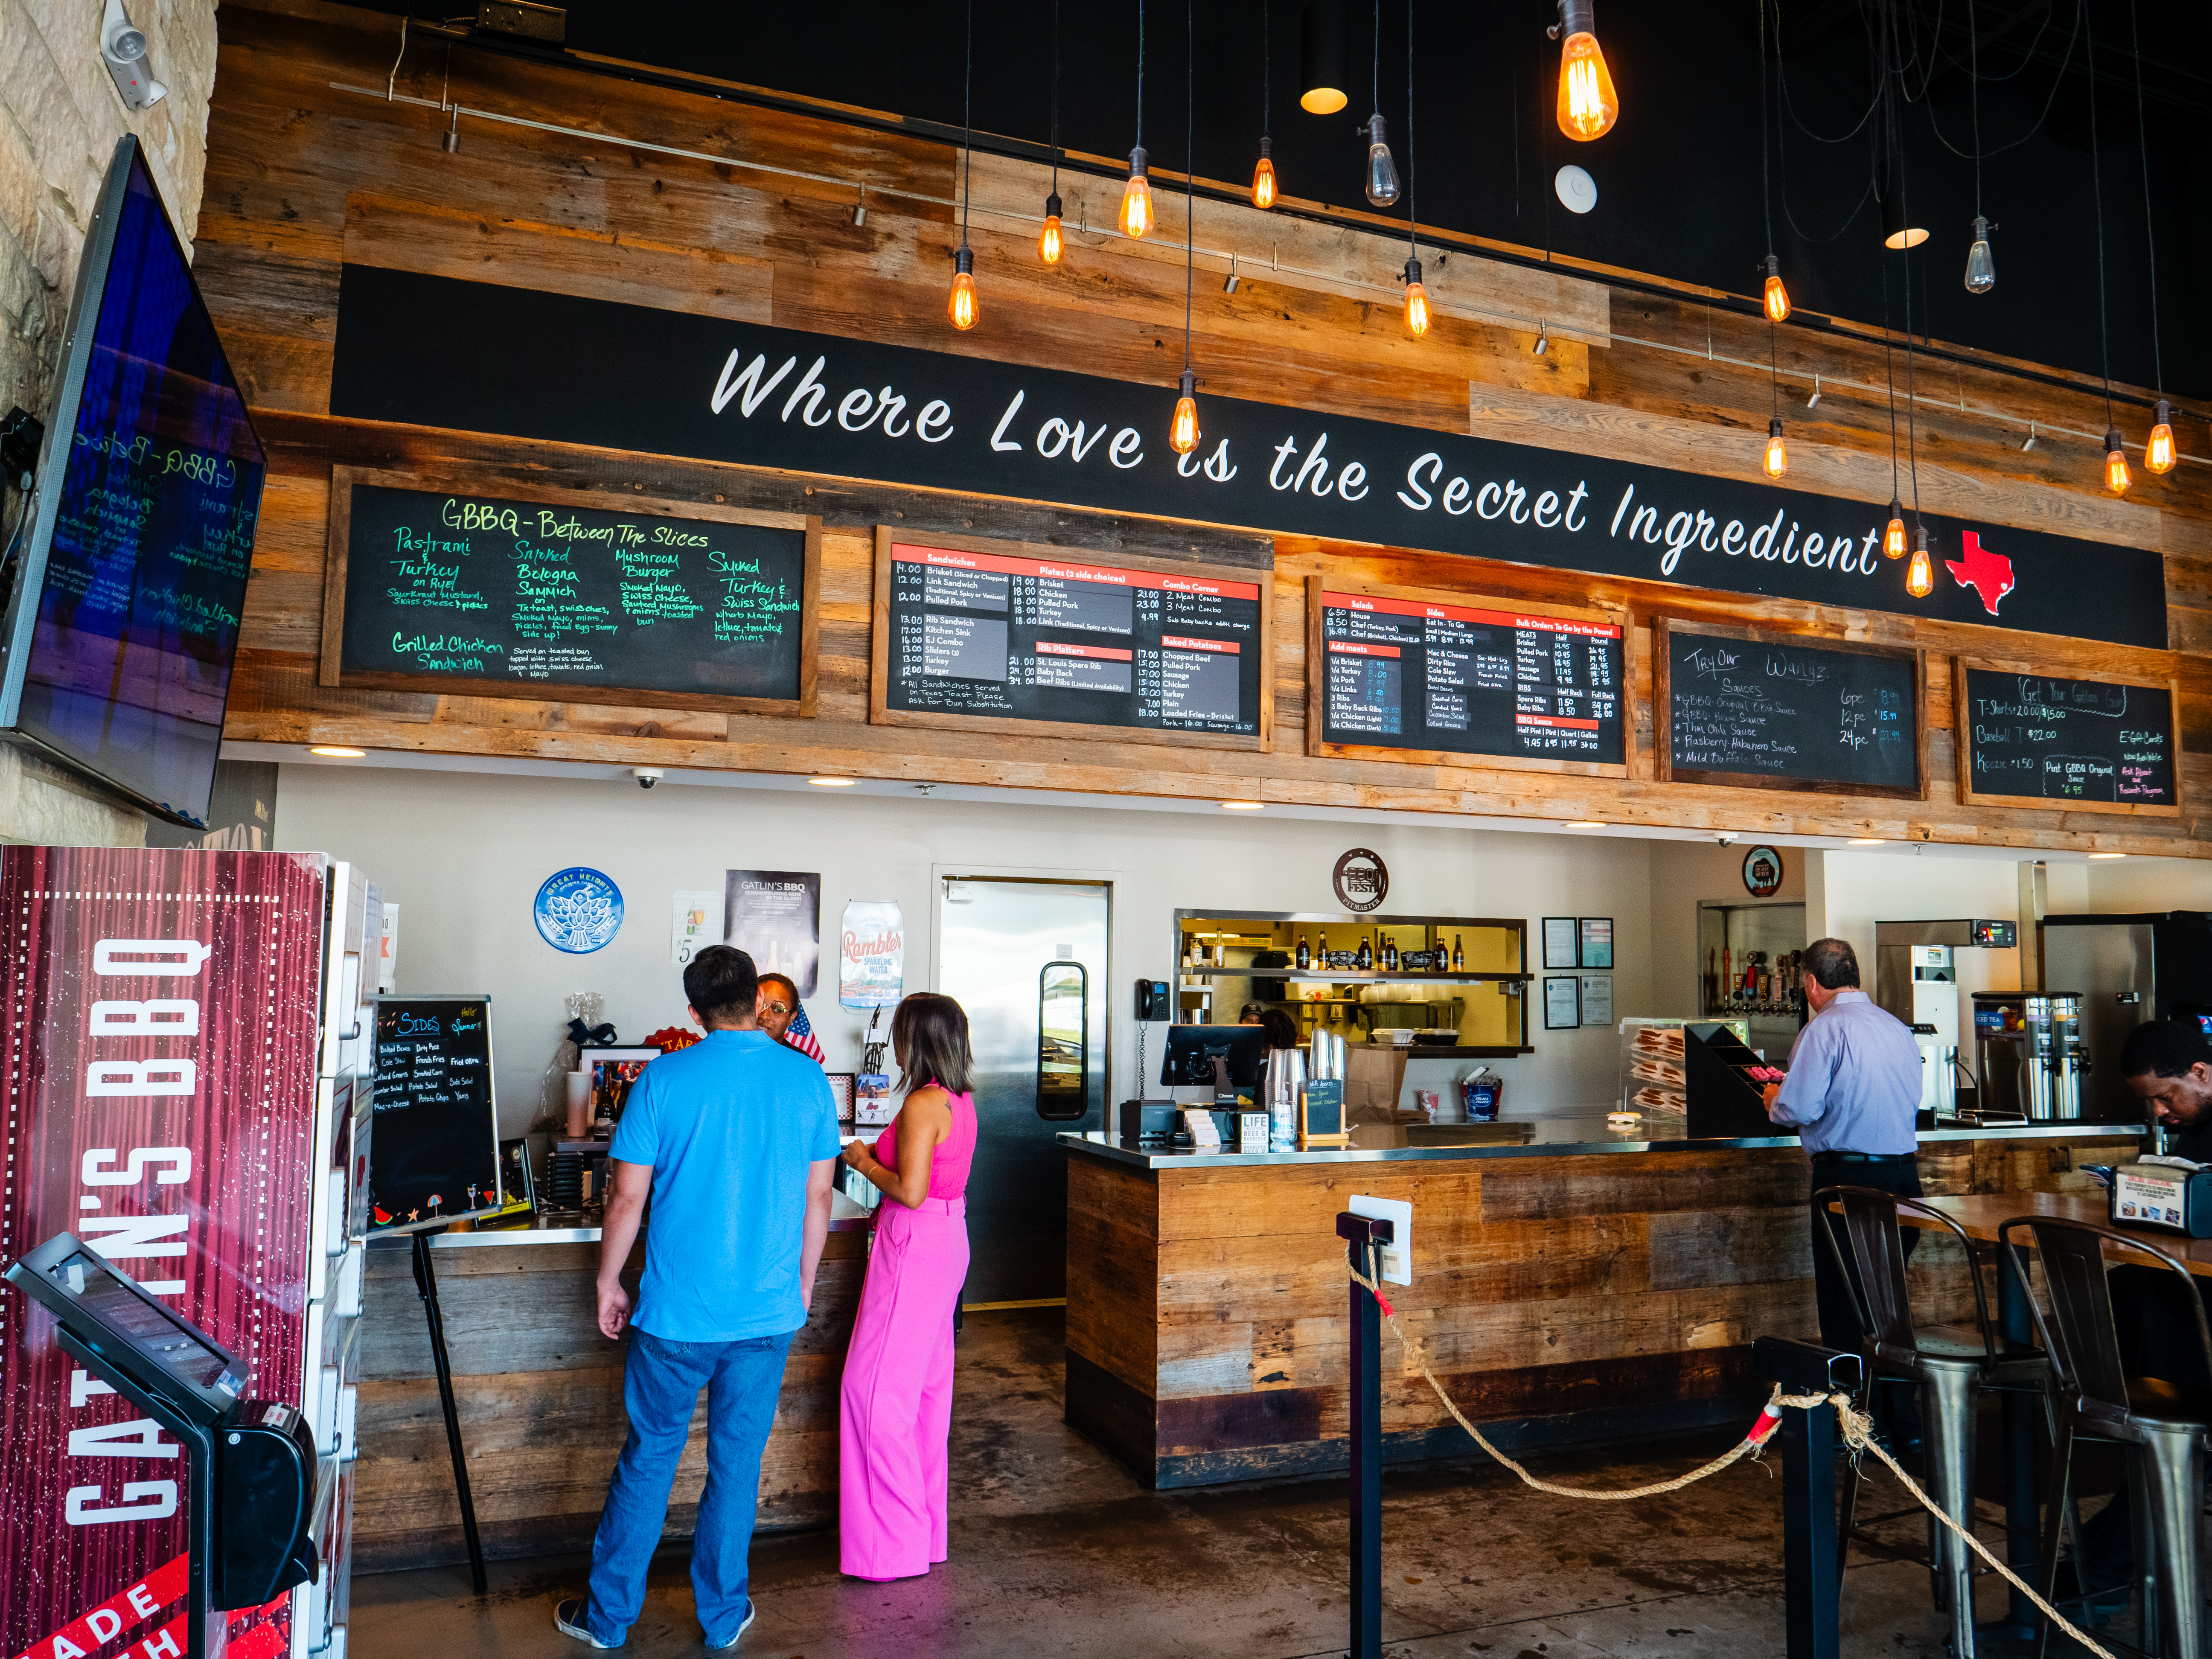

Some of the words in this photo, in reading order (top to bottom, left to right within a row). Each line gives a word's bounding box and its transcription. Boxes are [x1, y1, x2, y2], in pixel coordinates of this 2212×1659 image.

[711, 348, 954, 442] Where
[990, 389, 1144, 469] Love
[1269, 432, 1369, 502] the
[1396, 452, 1587, 532] Secret
[1610, 483, 1881, 576] Ingredient
[443, 499, 519, 536] GBBQ
[537, 511, 613, 547] Between
[617, 525, 646, 547] The
[650, 527, 708, 547] Slices
[394, 527, 471, 556] Pastrami
[927, 554, 976, 567] Sandwiches
[516, 564, 580, 585] Bologna
[622, 565, 675, 585] Burger
[927, 568, 952, 576] Brisket
[954, 570, 973, 579] (Sliced
[981, 574, 1008, 583] Chopped)
[1040, 566, 1065, 577] Plates
[1066, 569, 1074, 578] (2
[1076, 570, 1091, 579] side
[1093, 572, 1126, 584] choices)
[926, 577, 942, 585] Link
[943, 579, 978, 589] Sandwich
[1039, 579, 1064, 588] Brisket
[1163, 580, 1190, 591] Combo
[1192, 582, 1219, 593] Corner
[656, 584, 685, 597] Mayo,
[720, 578, 774, 602] Turkey
[1039, 589, 1067, 599] Chicken
[655, 594, 693, 604] Cheese,
[721, 596, 754, 608] Swiss
[758, 598, 799, 613] Sandwich
[926, 595, 949, 604] Pulled
[951, 598, 968, 606] Pork
[1176, 602, 1194, 612] Meat
[1351, 600, 1373, 610] Salads
[1039, 607, 1062, 617] Turkey
[1426, 608, 1445, 617] Sides
[926, 616, 938, 624] Rib
[940, 617, 974, 626] Sandwich
[1516, 619, 1530, 627] Bulk
[1531, 621, 1554, 630] Orders
[926, 626, 953, 635] Kitchen
[955, 629, 971, 637] Sink
[1367, 623, 1385, 632] (Turkey,
[544, 630, 559, 641] up!
[715, 632, 731, 642] red
[393, 632, 444, 653] Grilled
[448, 636, 504, 654] Chicken
[1164, 637, 1185, 647] Baked
[1188, 640, 1222, 650] Potatoes
[925, 646, 950, 655] Sliders
[1038, 643, 1051, 652] Rib
[1053, 644, 1084, 655] Platters
[1163, 651, 1194, 662] Chopped
[1196, 654, 1211, 662] Beef
[1447, 651, 1468, 659] Cheese
[416, 654, 484, 672] Sandwich
[925, 656, 949, 666] Turkey
[1048, 659, 1066, 668] Louis
[1068, 661, 1089, 670] Spare
[1090, 661, 1102, 670] Rib
[1341, 658, 1362, 667] Brisket
[1427, 658, 1441, 666] Dirty
[925, 667, 950, 676] Burger
[1037, 668, 1054, 678] Baby
[1163, 671, 1190, 680] Sausage
[1341, 667, 1361, 676] Turkey
[1037, 676, 1054, 685] Beef
[1055, 678, 1070, 686] Ribs
[1428, 675, 1447, 684] Potato
[1162, 699, 1179, 707] Plain
[1162, 709, 1186, 718] Loaded
[1187, 710, 1205, 719] Fries
[1517, 716, 1532, 724] BBQ
[1685, 722, 1705, 734] Thai
[1708, 723, 1726, 735] Chili
[1731, 725, 1756, 736] Sauce
[1772, 741, 1796, 754] Sauce
[1348, 867, 1375, 884] BBQ
[547, 874, 573, 895] GREAT
[579, 873, 613, 896] HEIGHTS
[742, 881, 782, 890] GATLIN'S
[784, 883, 805, 893] BBQ
[1348, 884, 1375, 892] FEST
[1343, 898, 1380, 910] PITMASTER
[844, 931, 901, 963] Rambler
[86, 939, 211, 1096] BBQ
[1244, 1117, 1266, 1127] LIFE
[65, 1147, 192, 1526] GATN'S
